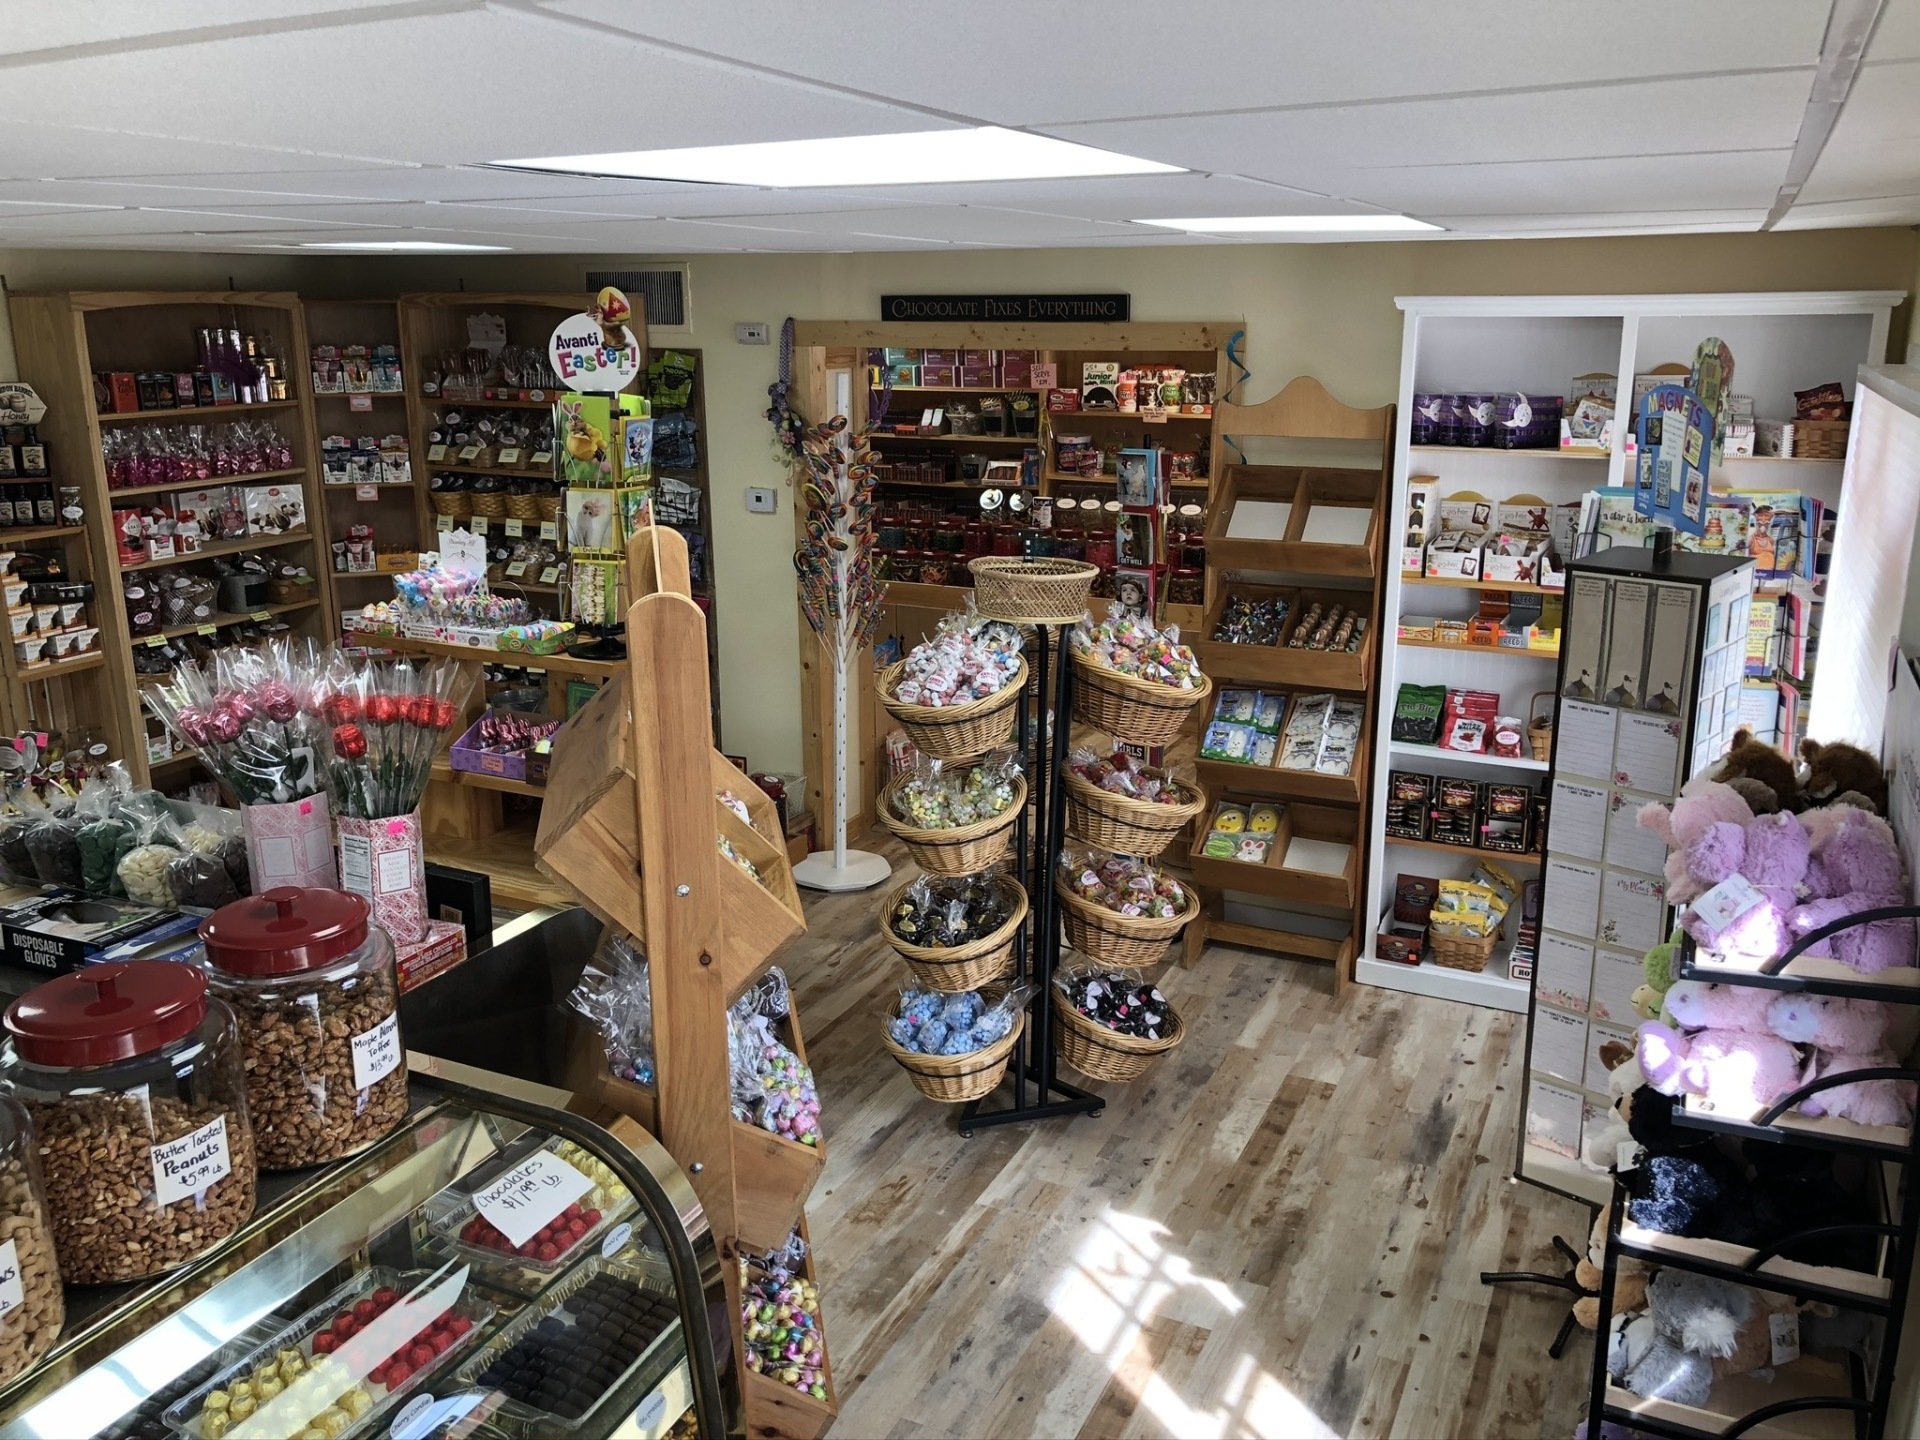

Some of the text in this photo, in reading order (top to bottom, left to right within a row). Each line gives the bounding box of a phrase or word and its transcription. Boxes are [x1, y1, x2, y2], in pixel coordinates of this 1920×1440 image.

[892, 300, 1116, 318] CHOCOLATE FIXES EVERYTHING
[556, 332, 599, 350] Avanti
[557, 346, 637, 380] Easter!
[2, 411, 30, 423] Honey
[1648, 390, 1703, 427] MAGNETS
[1627, 513, 1633, 523] is
[13, 933, 64, 956] DISPOSABLE
[24, 949, 56, 968] GLOVES
[354, 1034, 377, 1049] Maple
[368, 1039, 391, 1057] Toffee
[153, 1120, 222, 1164] Butter Toasted
[163, 1143, 219, 1178] Peanuts
[179, 1165, 209, 1186] $5.99
[477, 1161, 543, 1208] Chocolates
